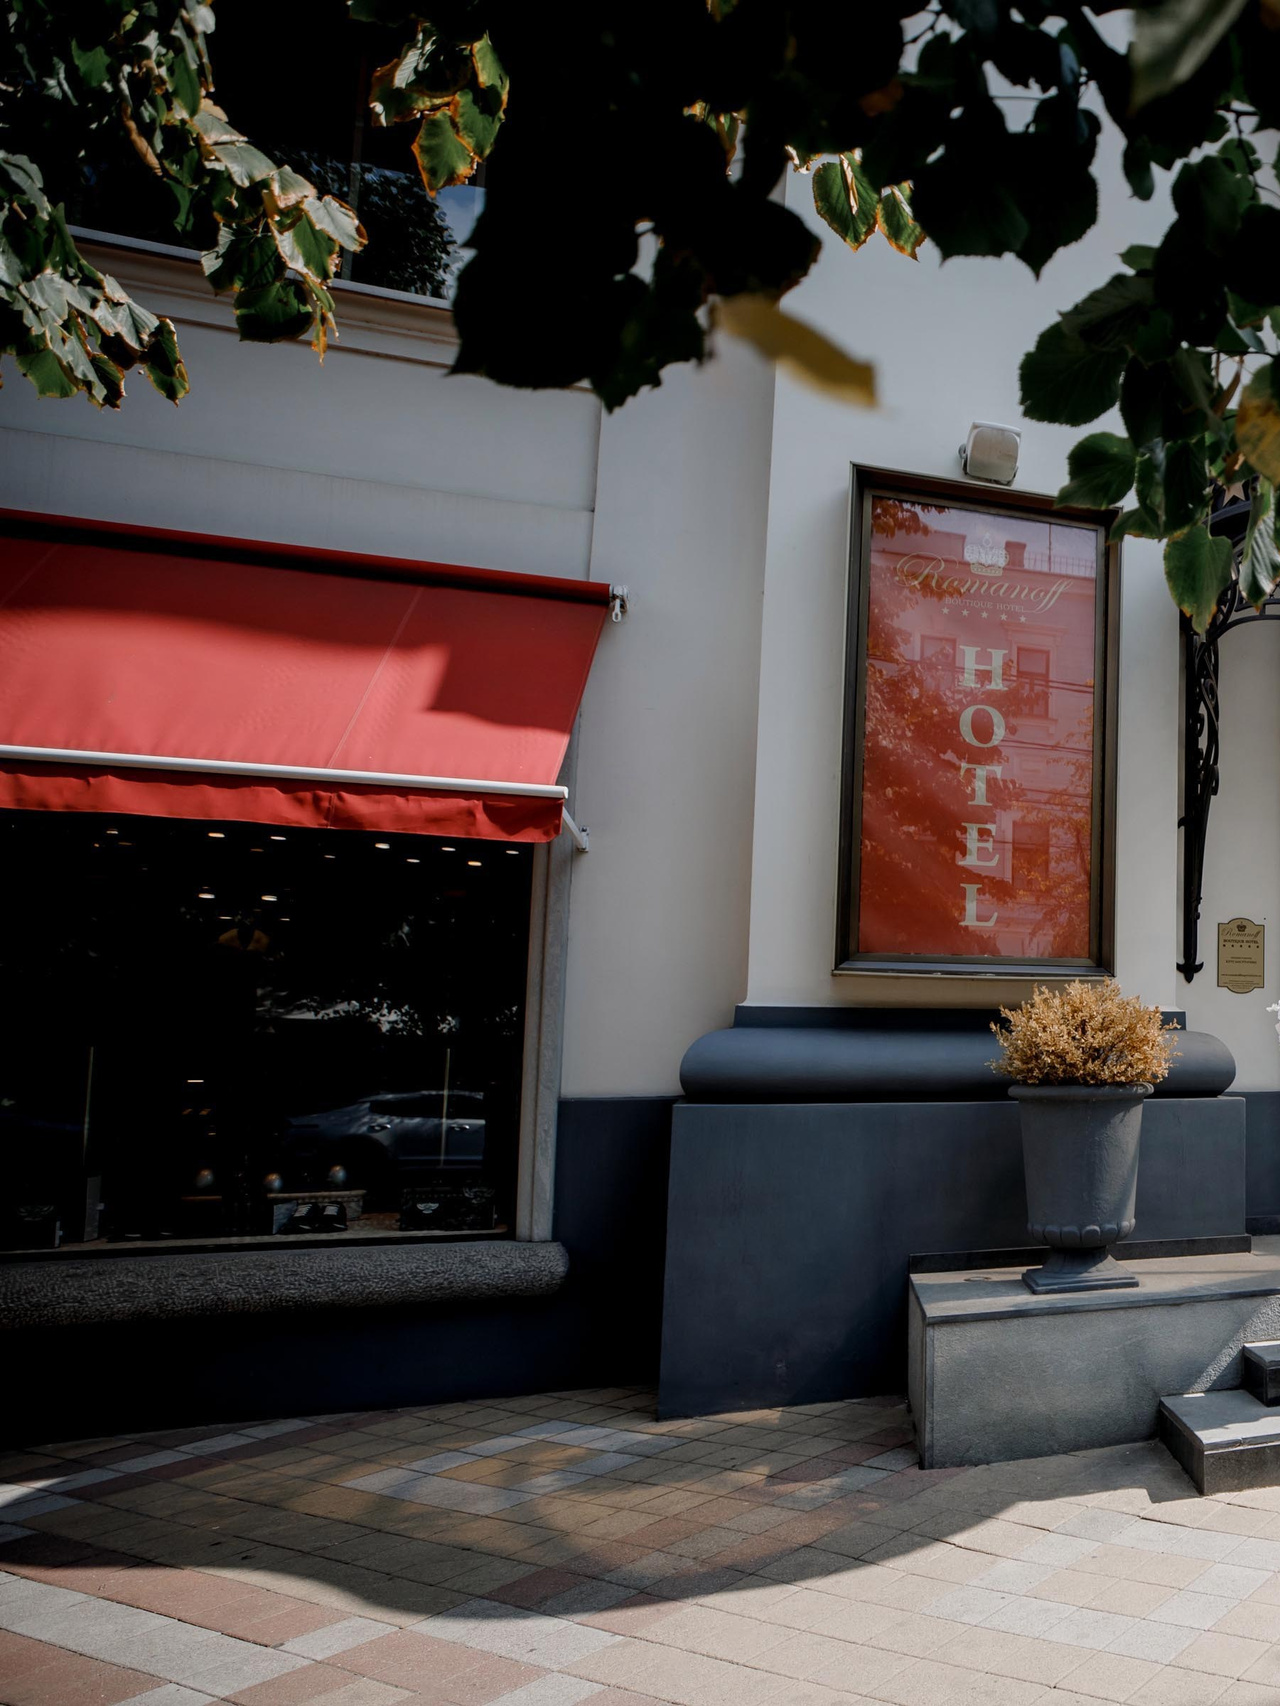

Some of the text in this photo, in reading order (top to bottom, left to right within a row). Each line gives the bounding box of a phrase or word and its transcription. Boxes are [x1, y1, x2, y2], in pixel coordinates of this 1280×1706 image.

[895, 553, 1073, 613] Romanoff
[945, 598, 1024, 612] BOUTIQUE HOTEL
[959, 645, 1008, 927] HOTEL
